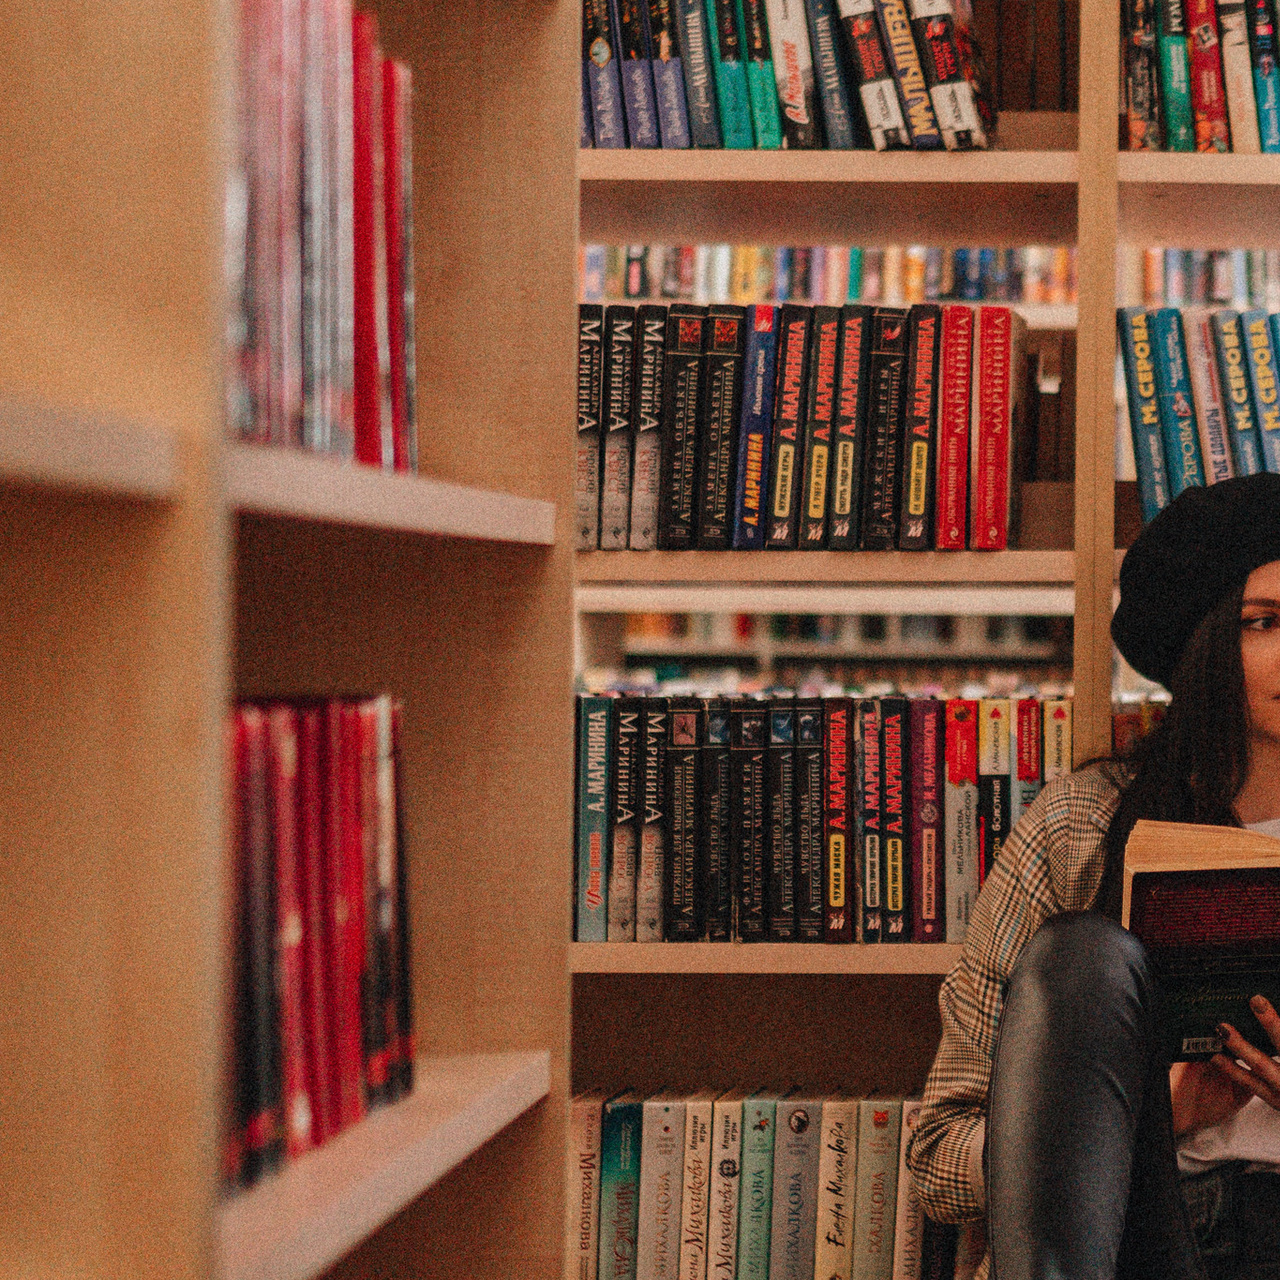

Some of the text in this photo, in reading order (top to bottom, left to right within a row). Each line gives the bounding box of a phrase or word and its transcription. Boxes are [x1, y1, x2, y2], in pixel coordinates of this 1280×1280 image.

[609, 319, 633, 432] МАРИНИНА
[640, 319, 664, 432] МАРИНИНА
[781, 320, 806, 421] МАРИНИНА
[815, 321, 837, 421] МАРИНИНА
[839, 317, 863, 417] МАРИНИНА
[913, 317, 935, 417] МАРИНИНА
[953, 316, 969, 435] МАРИНИНА
[991, 316, 1006, 435] МАРИНИНА
[1131, 314, 1155, 398] СЕРОВА
[1222, 319, 1249, 404] СЕРОВА
[1249, 319, 1277, 404] СЕРОВА
[680, 440, 694, 522] АЛЕКСАНДРА
[714, 439, 731, 522] АЛЕКСАНДРА
[745, 432, 763, 510] МАРИНИНА
[587, 711, 606, 794] МАРИНИНА
[616, 712, 638, 824] МАРИНИНА
[644, 712, 666, 824] МАРИНИНА
[830, 710, 847, 810] МАРИНИНА
[885, 714, 902, 813] МАРИНИНА
[682, 754, 695, 916] АЛЕКСАНДРА МАРИНИНА
[579, 1152, 596, 1250] Михалкова
